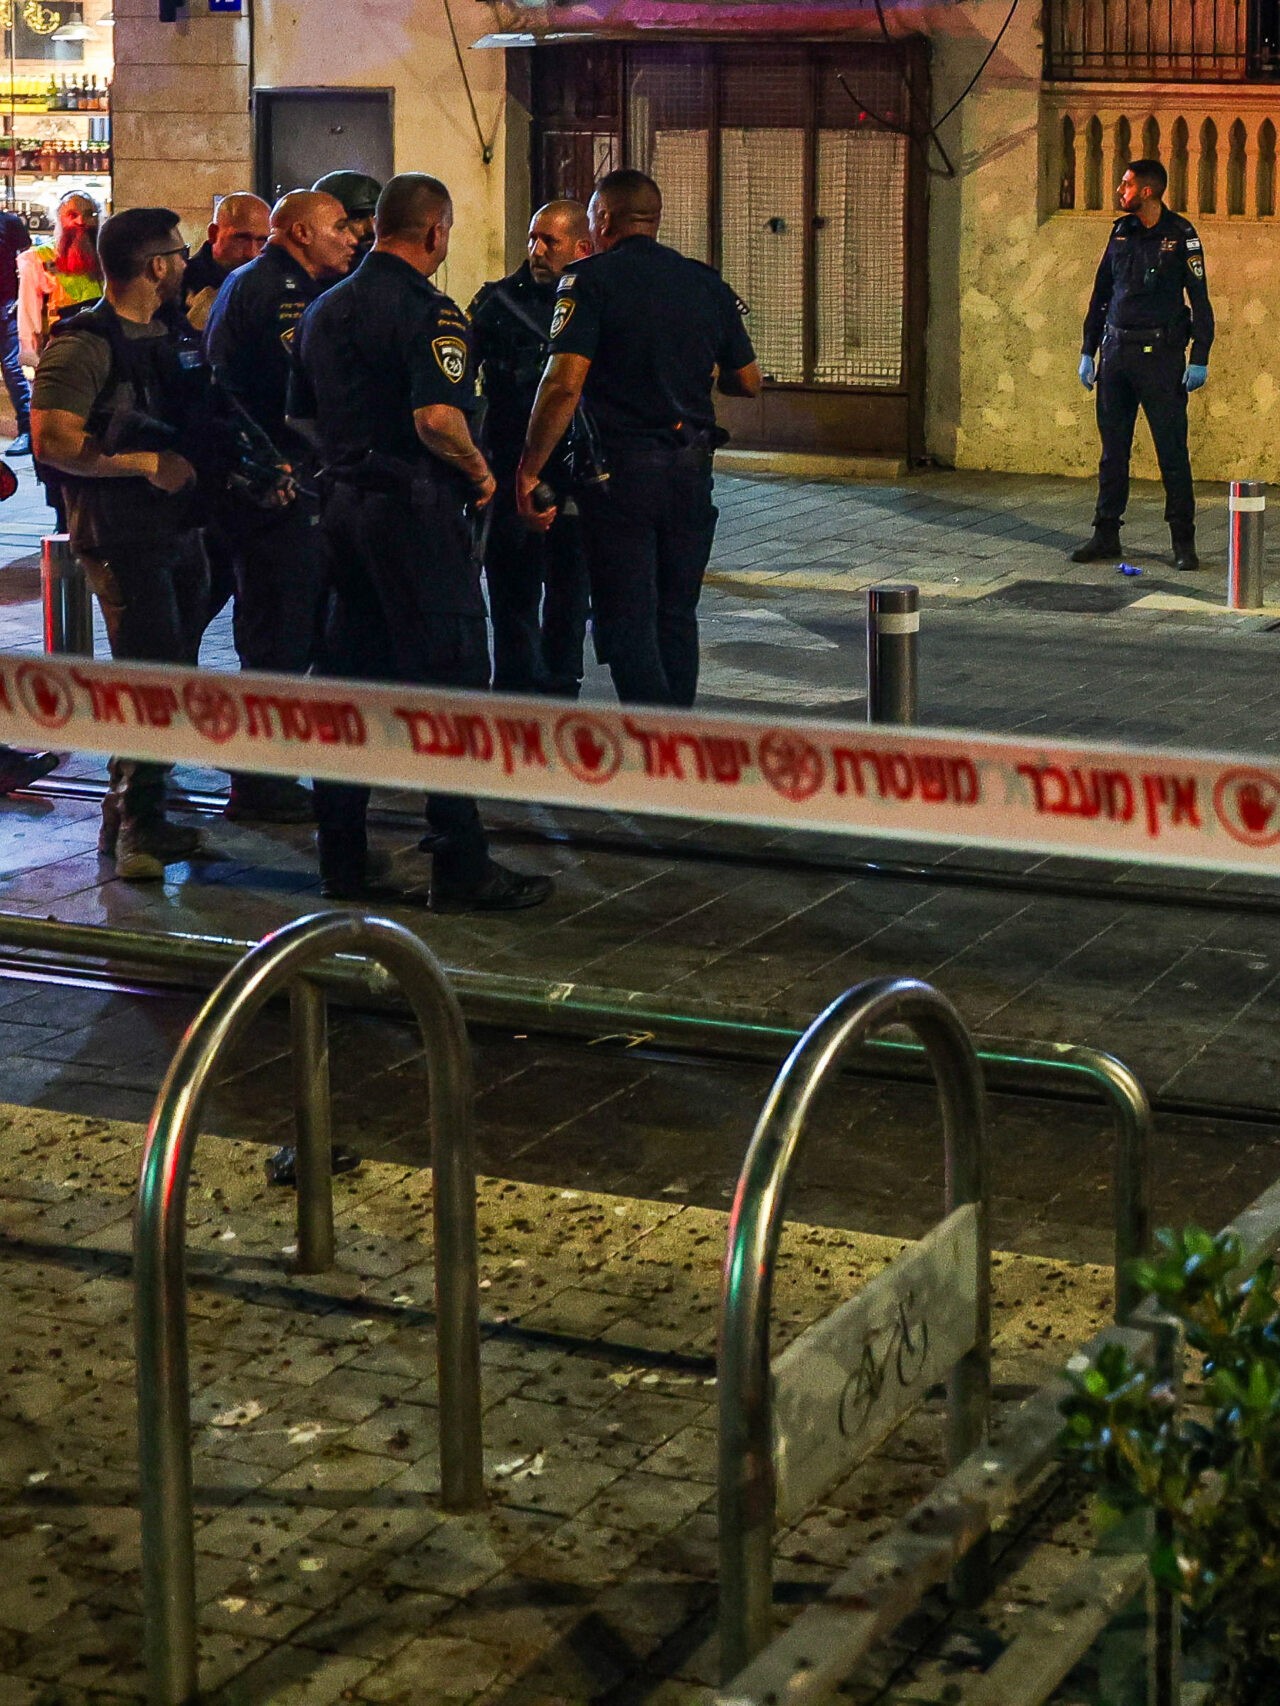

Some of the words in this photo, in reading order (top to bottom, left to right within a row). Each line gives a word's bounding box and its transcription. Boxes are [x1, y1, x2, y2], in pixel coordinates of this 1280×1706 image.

[245, 695, 367, 745] משטרת
[394, 709, 494, 761] מעבר
[500, 719, 547, 776] אין
[624, 716, 752, 784] ישראל
[832, 748, 980, 804] משטרת
[1017, 763, 1135, 823] מעבר
[1140, 772, 1202, 837] אין
